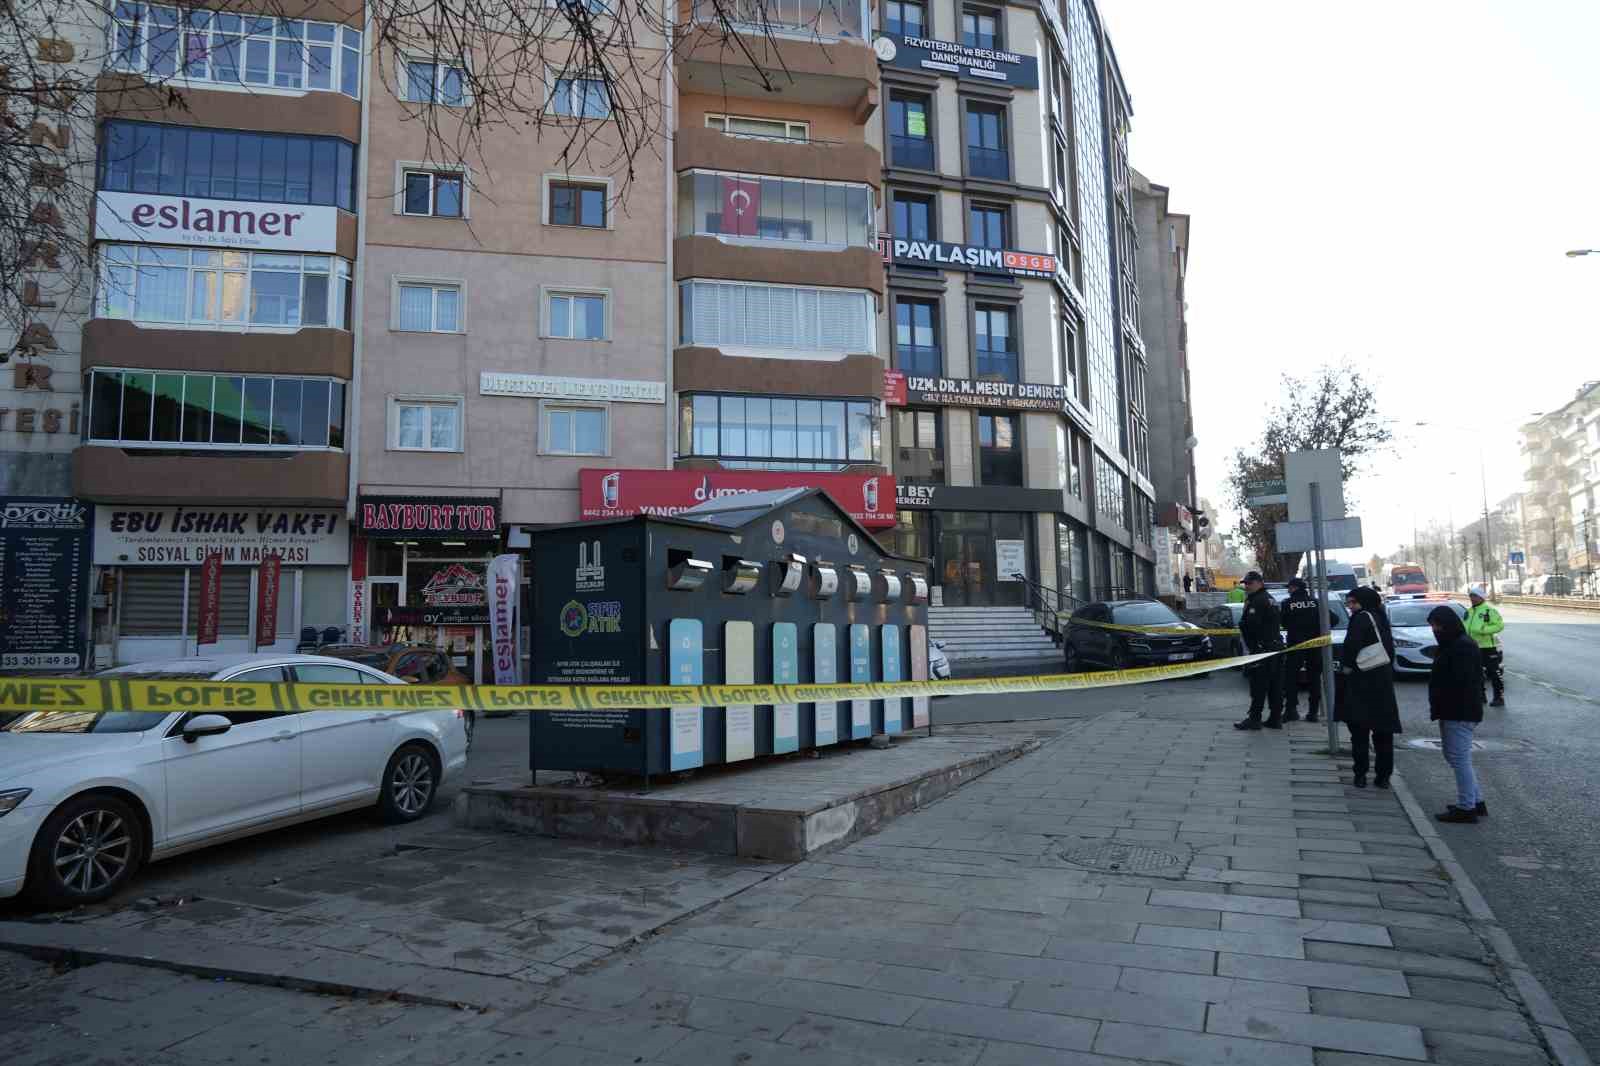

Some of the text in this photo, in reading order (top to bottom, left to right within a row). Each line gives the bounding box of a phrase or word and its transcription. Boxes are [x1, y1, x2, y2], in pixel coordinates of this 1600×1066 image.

[131, 199, 302, 237] eslamer
[894, 240, 1002, 269] PAYLAŞIM
[908, 376, 937, 392] UZM.
[939, 378, 959, 393] DR.
[961, 380, 974, 394] M.
[976, 382, 1015, 397] MESUT
[908, 485, 936, 498] BEY
[110, 507, 338, 535] EBU İSHAK VAKFI
[363, 503, 496, 531] BAYBURT TUR
[138, 543, 310, 562] SOSYAL GİYİM MAĞAZASI
[496, 575, 513, 672] eslamer
[22, 656, 41, 666] 301
[47, 656, 60, 666] 49
[64, 656, 77, 666] 84
